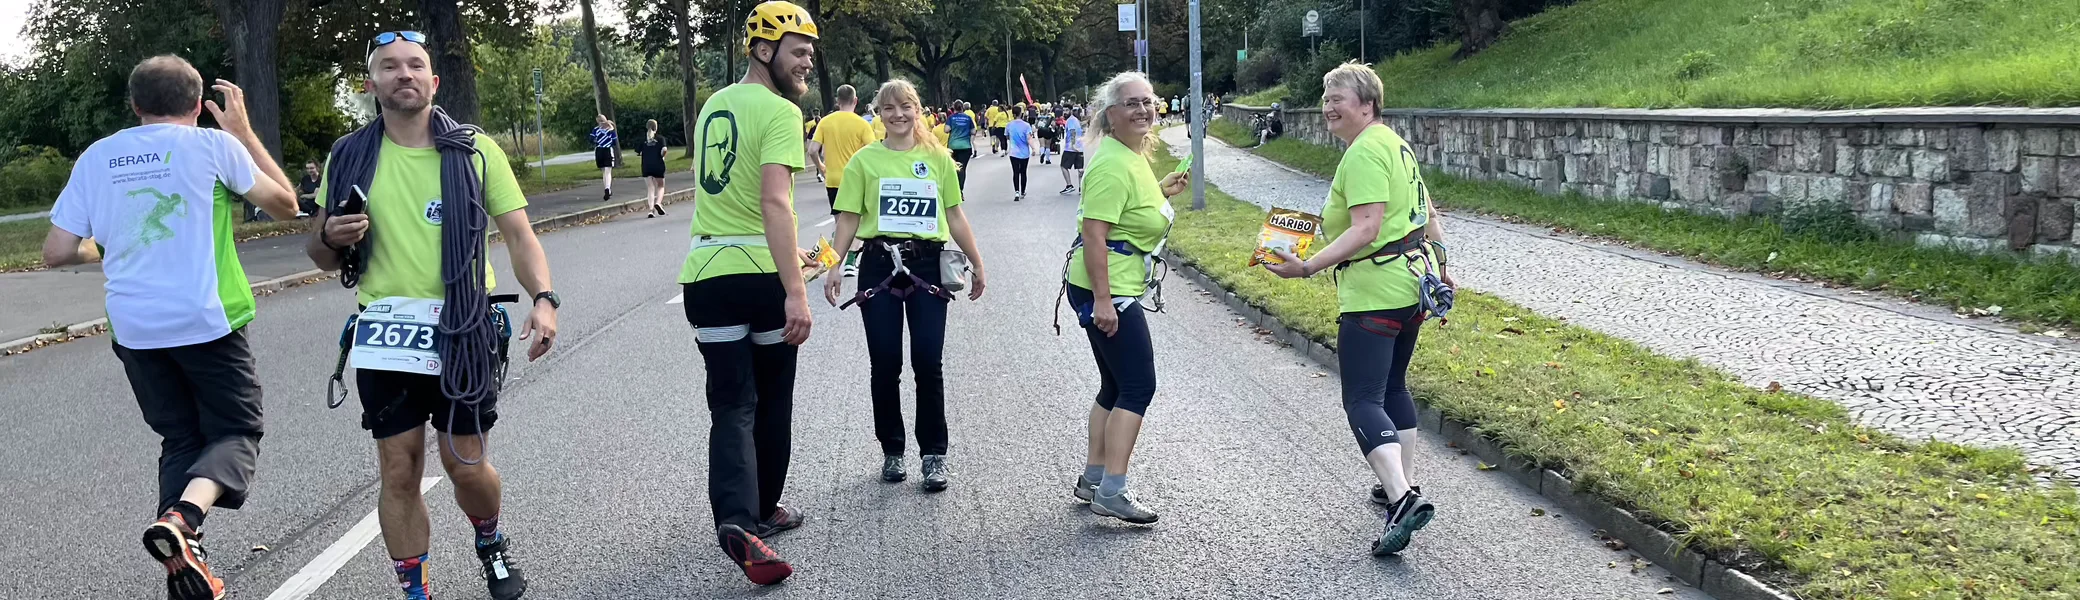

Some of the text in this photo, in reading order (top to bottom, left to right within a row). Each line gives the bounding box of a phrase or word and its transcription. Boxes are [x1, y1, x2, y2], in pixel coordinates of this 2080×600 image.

[109, 153, 161, 168] BERATA
[886, 197, 931, 216] 2677
[1269, 214, 1313, 232] HARIBO
[366, 322, 435, 350] 2673
